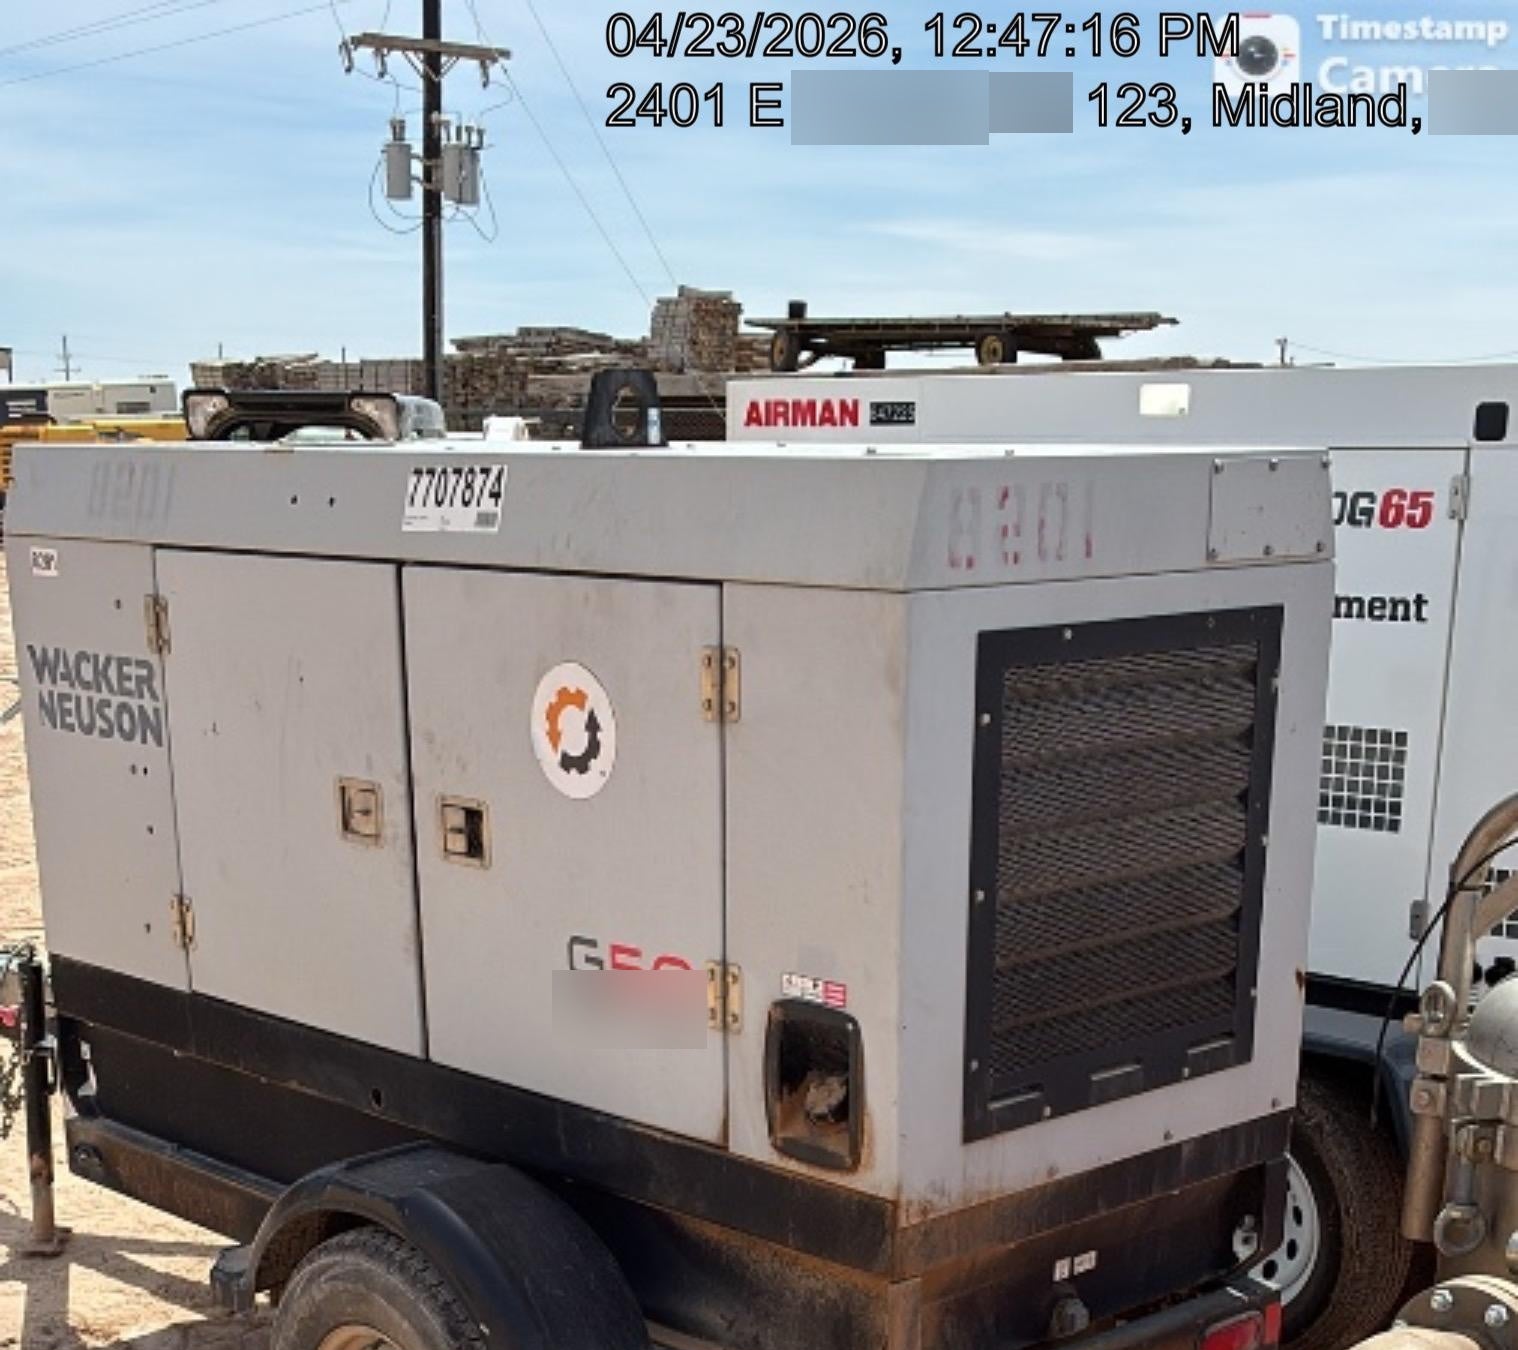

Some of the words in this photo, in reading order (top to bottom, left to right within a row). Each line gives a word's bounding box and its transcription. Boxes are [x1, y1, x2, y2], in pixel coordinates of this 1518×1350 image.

[744, 399, 859, 426] AIRMAN
[408, 467, 504, 508] 7707874
[27, 644, 159, 702] WACKER
[39, 689, 163, 747] NEUSON
